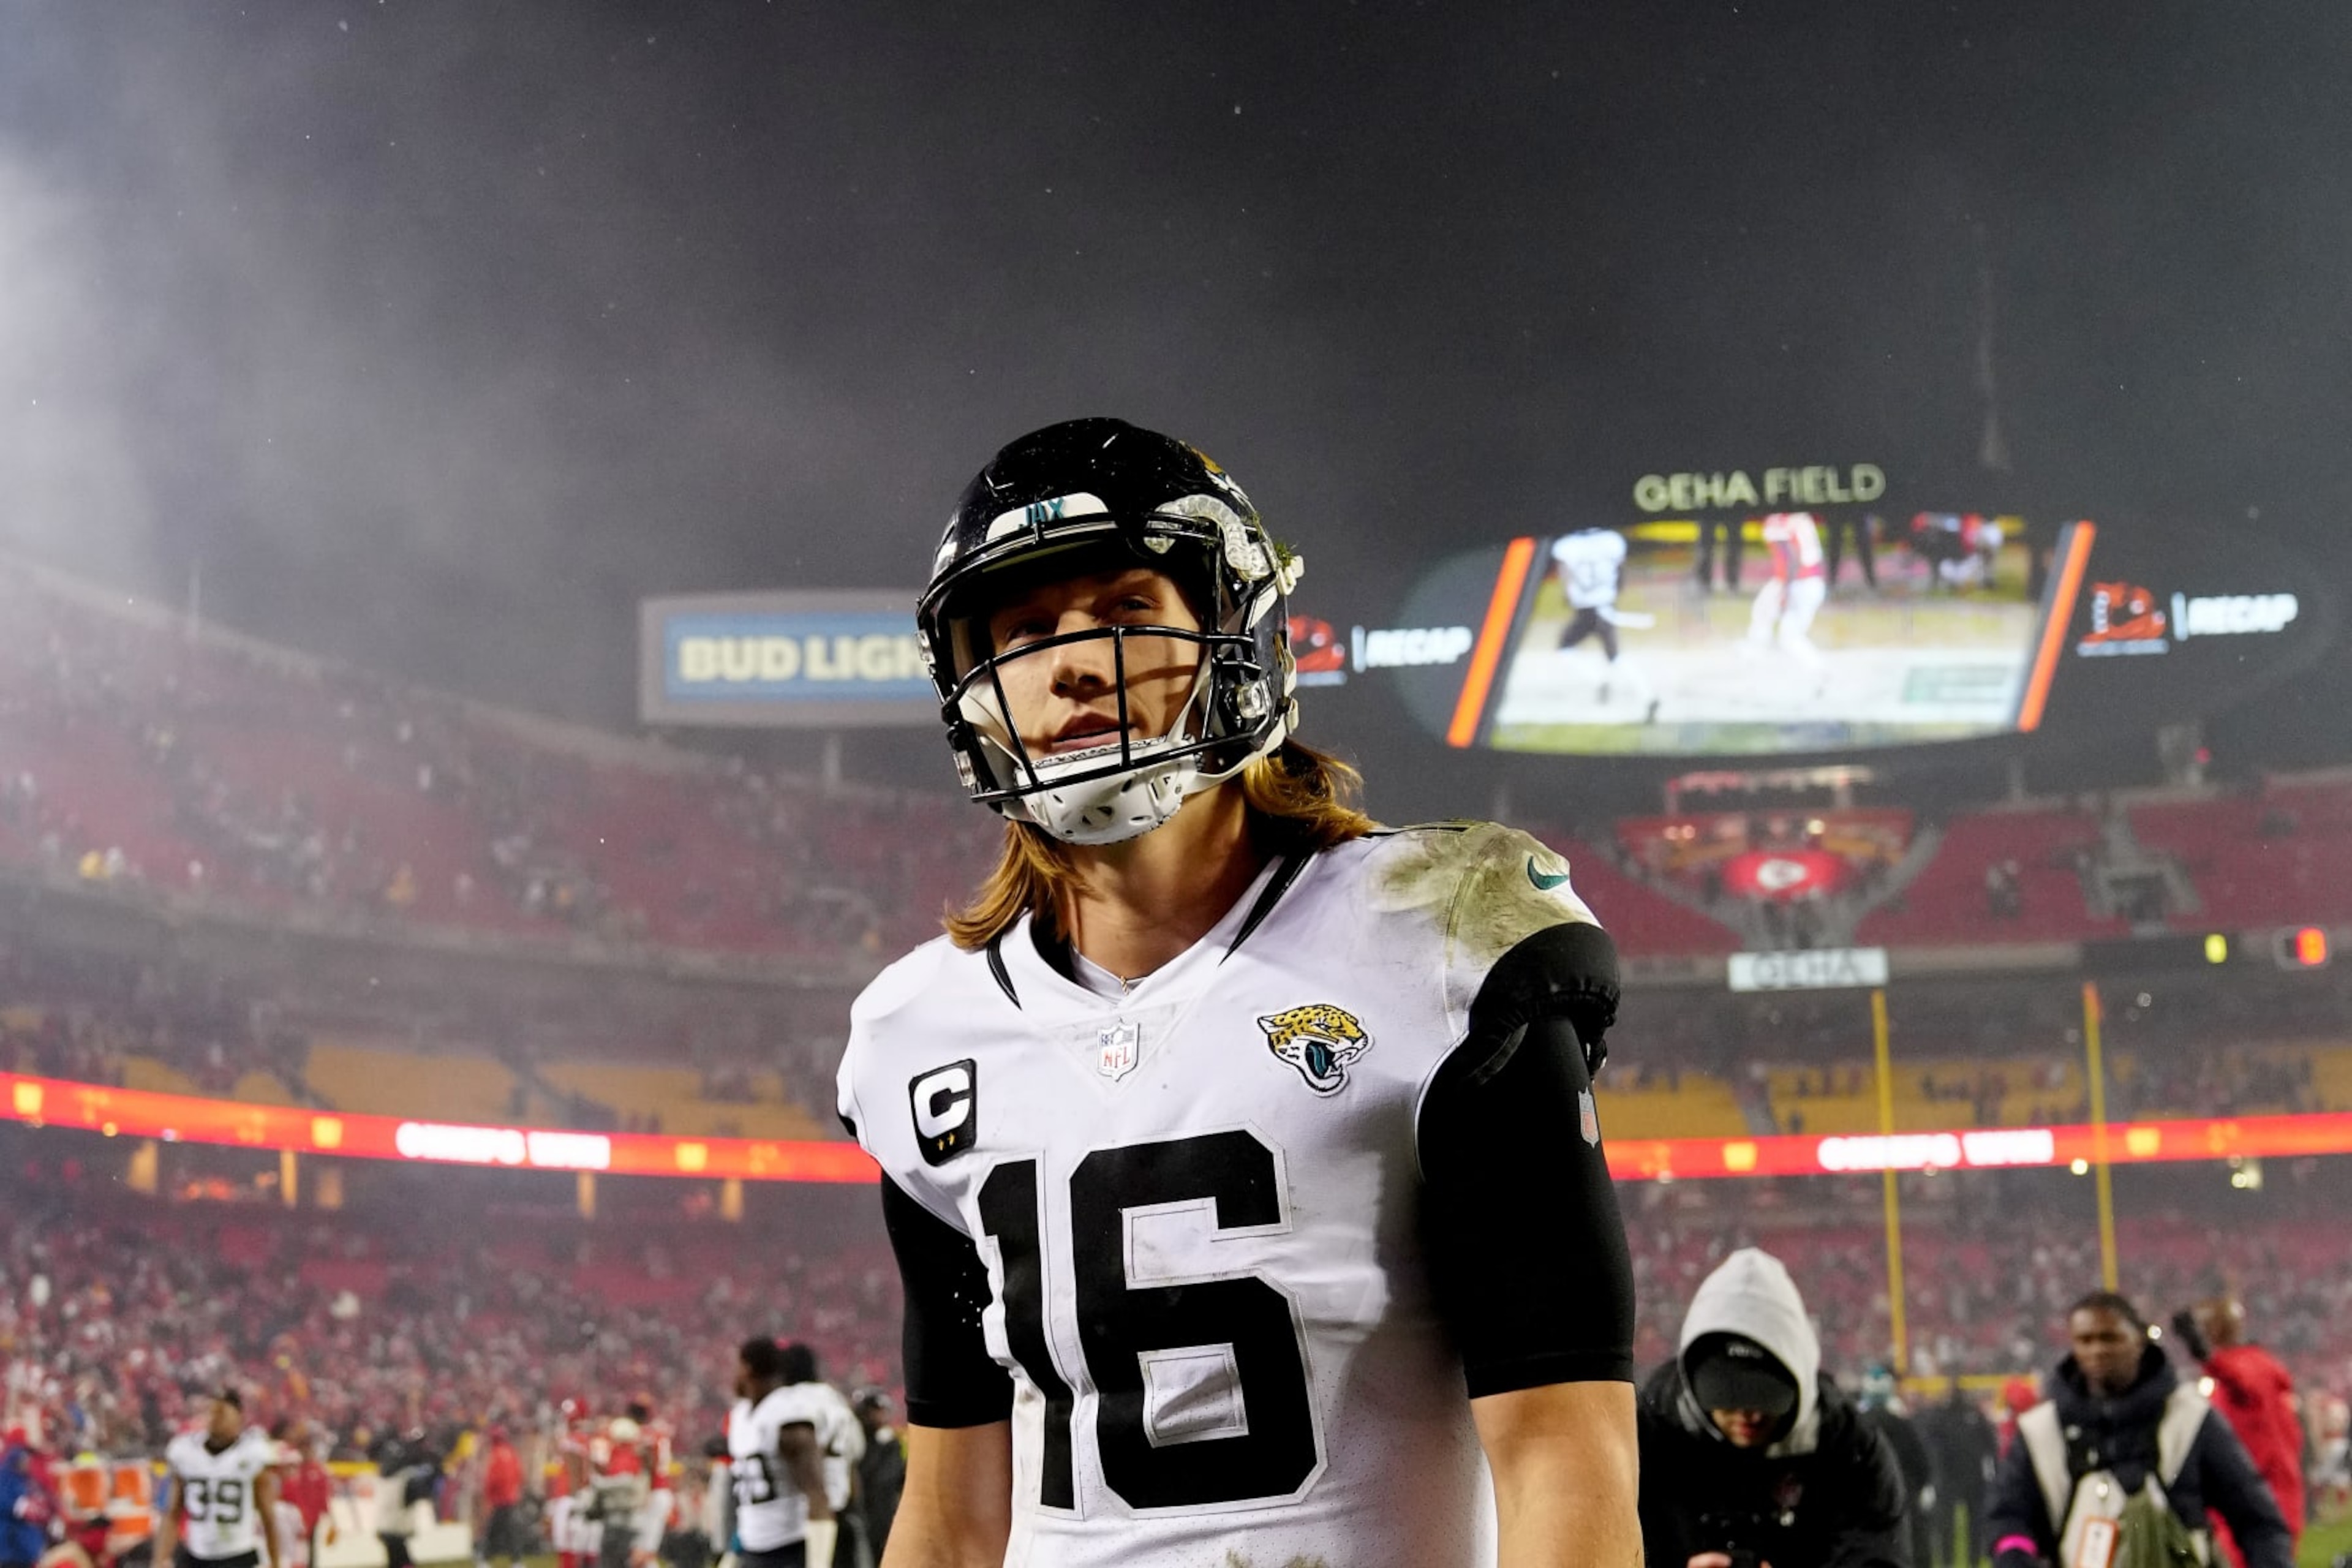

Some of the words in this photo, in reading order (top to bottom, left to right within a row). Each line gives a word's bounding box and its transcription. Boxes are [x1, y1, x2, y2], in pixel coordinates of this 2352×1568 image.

[1019, 496, 1065, 528] JAX
[1634, 470, 1758, 512] GEHA
[1764, 463, 1887, 505] FIELD
[679, 636, 801, 682] BUD
[803, 633, 930, 680] LIGH
[1103, 1046, 1131, 1068] NFL
[913, 1068, 970, 1139] C
[975, 1128, 1321, 1511] 16
[186, 1479, 243, 1523] 39
